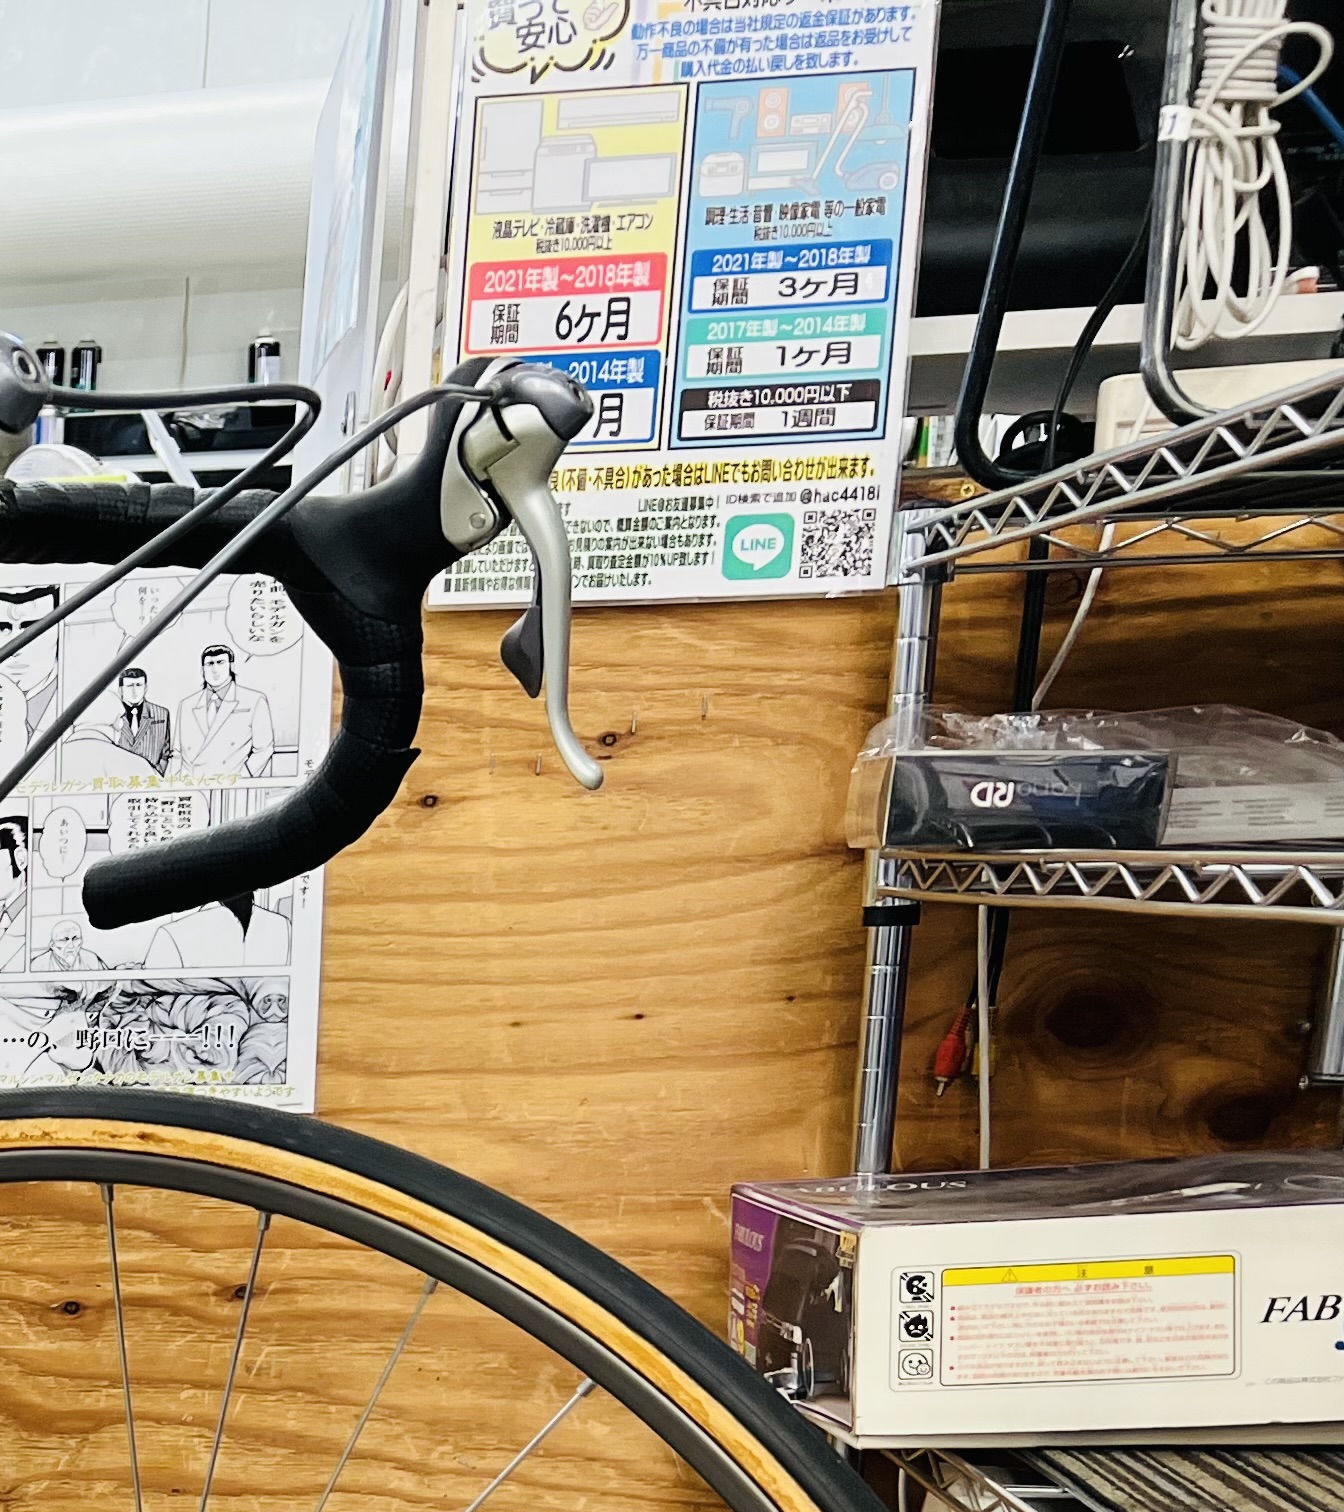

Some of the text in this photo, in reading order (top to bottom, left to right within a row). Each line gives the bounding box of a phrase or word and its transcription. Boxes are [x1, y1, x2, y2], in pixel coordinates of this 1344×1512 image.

[516, 17, 578, 54] 安心
[704, 406, 836, 431] 保証期間 1週間
[740, 535, 777, 553] LINE
